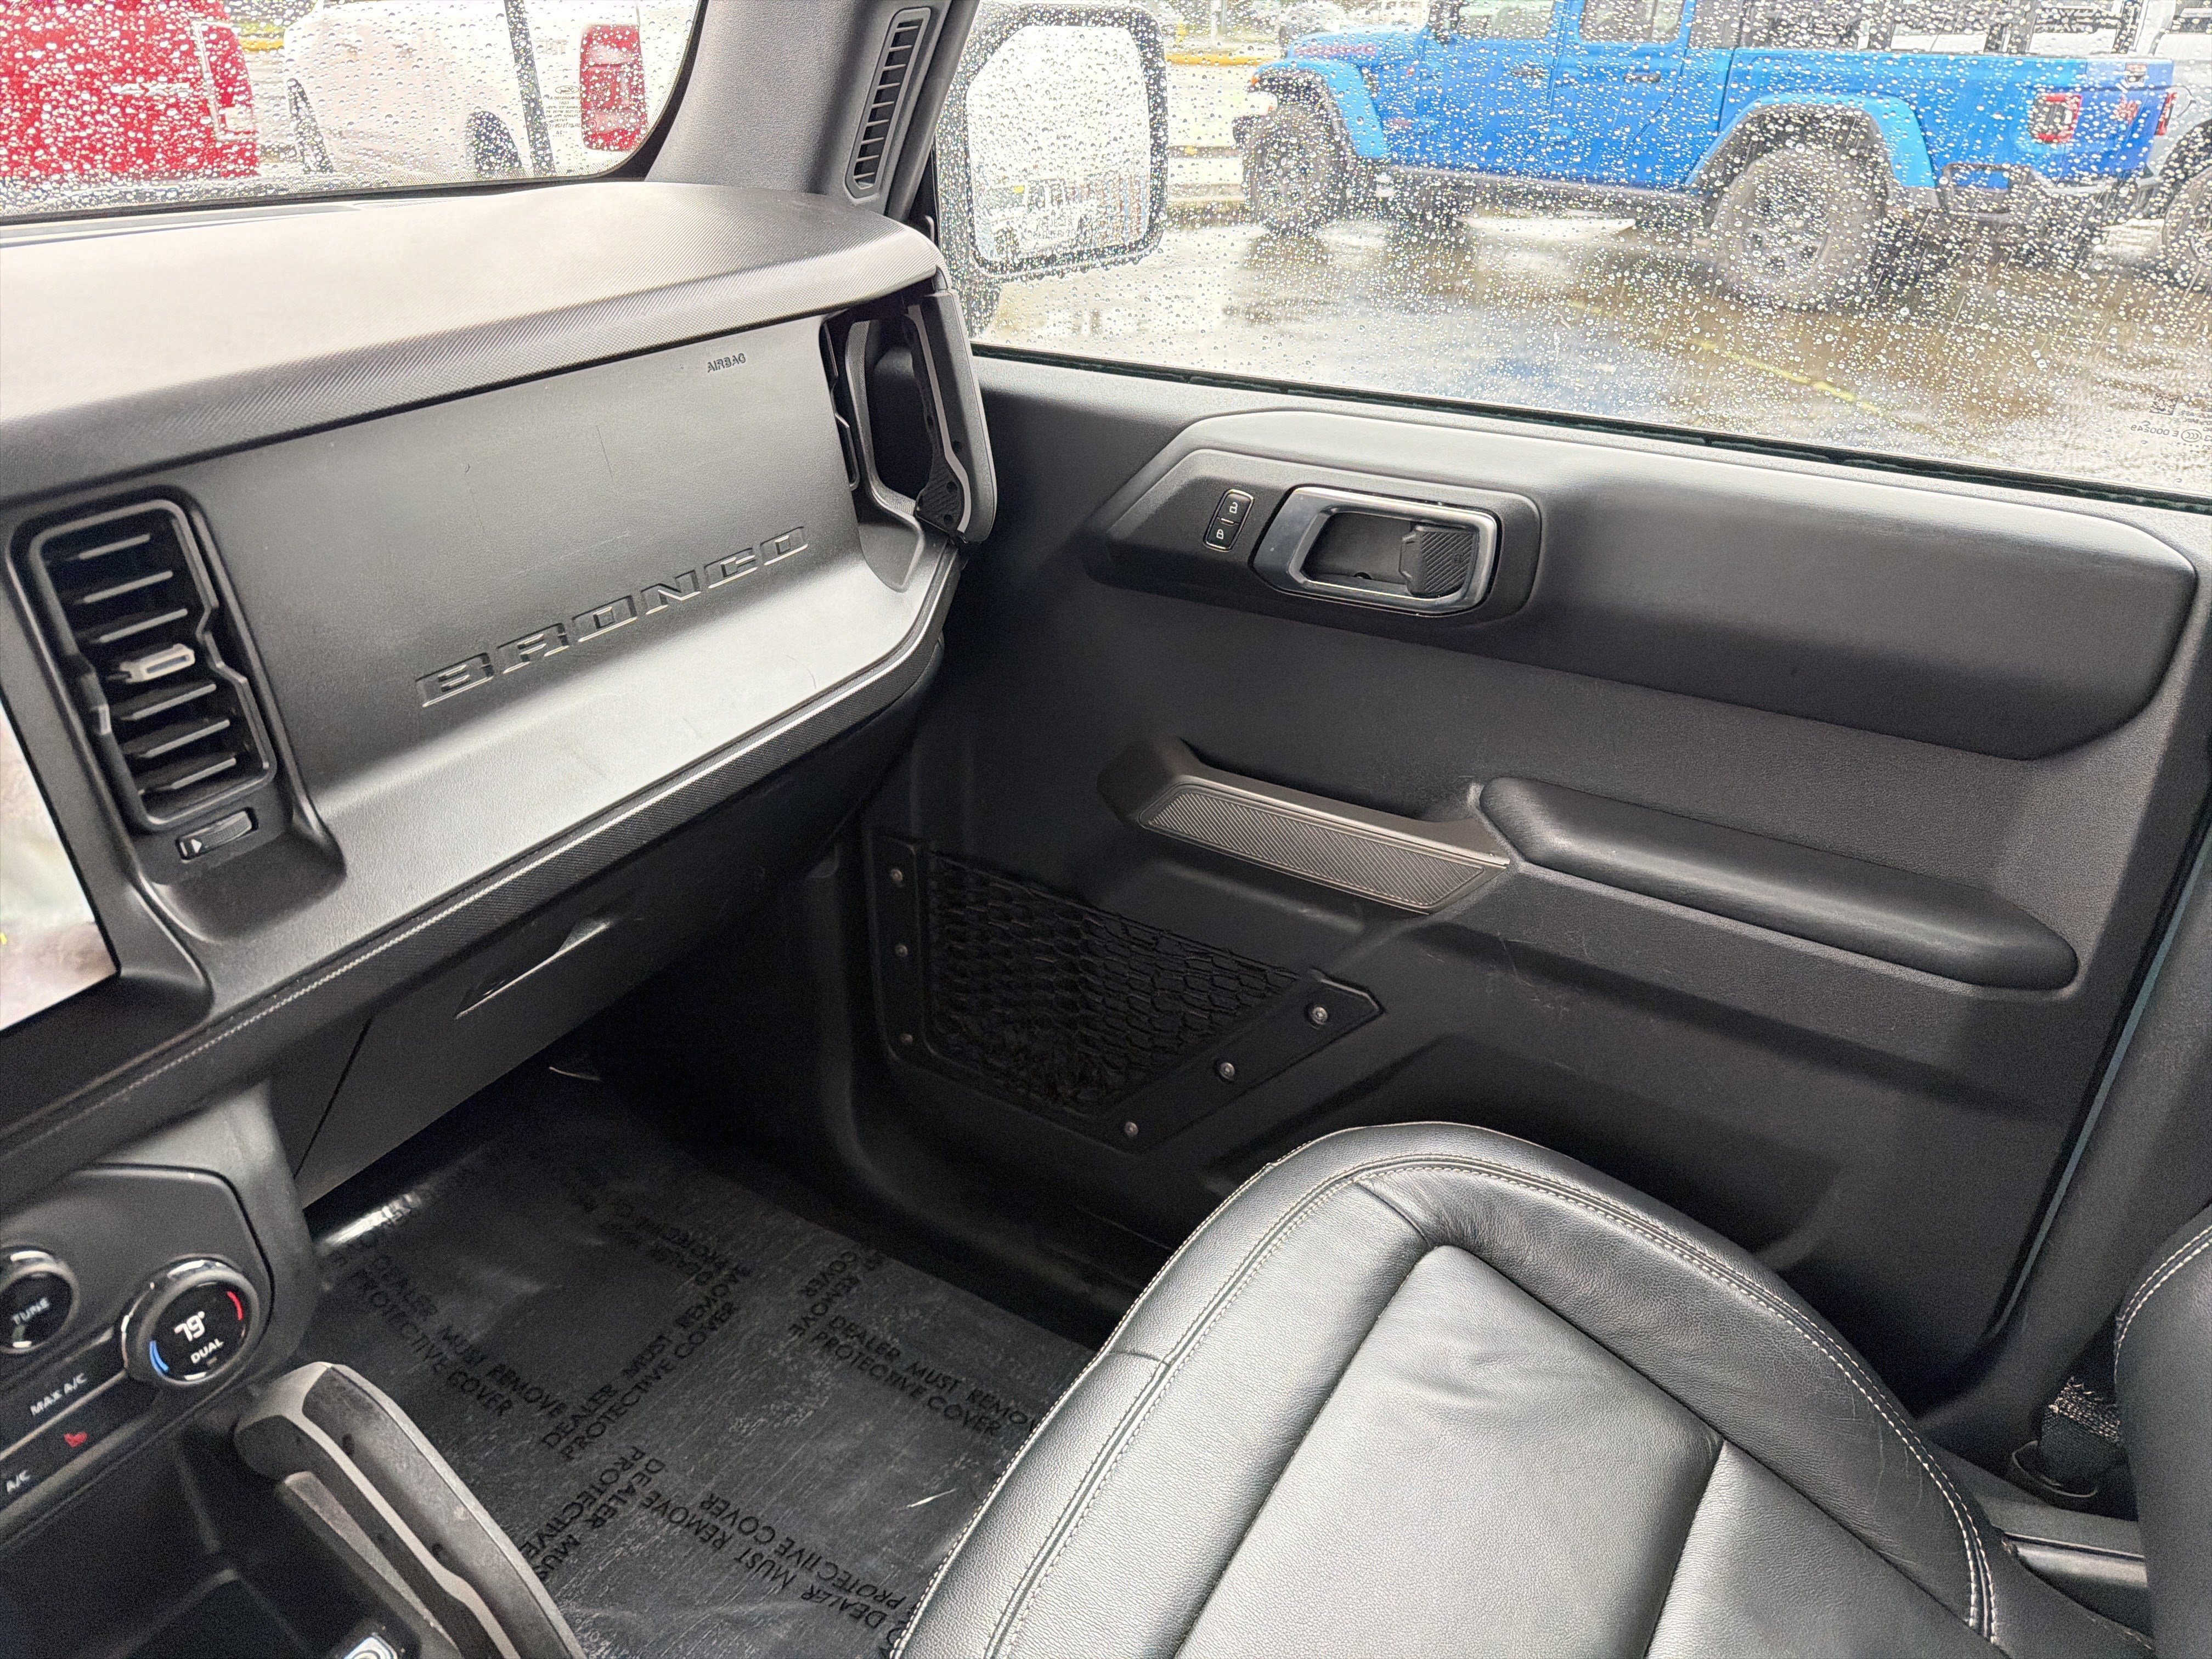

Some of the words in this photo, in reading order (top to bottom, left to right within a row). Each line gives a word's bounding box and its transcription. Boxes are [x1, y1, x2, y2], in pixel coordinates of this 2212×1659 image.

[707, 353, 747, 373] AIRBAG
[415, 526, 808, 708] BRONCO
[787, 1274, 862, 1338] REMOVE
[797, 1250, 858, 1299] COVER
[190, 1338, 224, 1364] DUAL
[347, 1267, 449, 1375] PROTECTIVE
[447, 1369, 514, 1417] COVER
[372, 1254, 438, 1318] DEALER
[437, 1324, 487, 1366] MUST
[486, 1362, 567, 1420] REMOVE
[540, 1383, 619, 1450] DEALER
[620, 1333, 673, 1379] MUST
[674, 1262, 752, 1330] REMOVE
[827, 1315, 902, 1362] DEALER
[906, 1361, 963, 1394] MUST
[30, 1388, 63, 1416] MAX
[64, 1373, 87, 1395] A/C
[558, 1359, 678, 1463] PROTECTIVE
[674, 1301, 740, 1359] COVER
[812, 1331, 927, 1400] PROTECTIVE
[926, 1395, 1002, 1437] COVER
[5, 1470, 31, 1493] A/C
[519, 1445, 646, 1561] PROTECTIVE
[582, 1457, 666, 1530] DEALER
[639, 1489, 733, 1553] REMOVE
[699, 1491, 777, 1545] COVER
[734, 1547, 798, 1591] MUST
[774, 1535, 907, 1610] PROTECTIVE
[800, 1583, 889, 1629] DEALER
